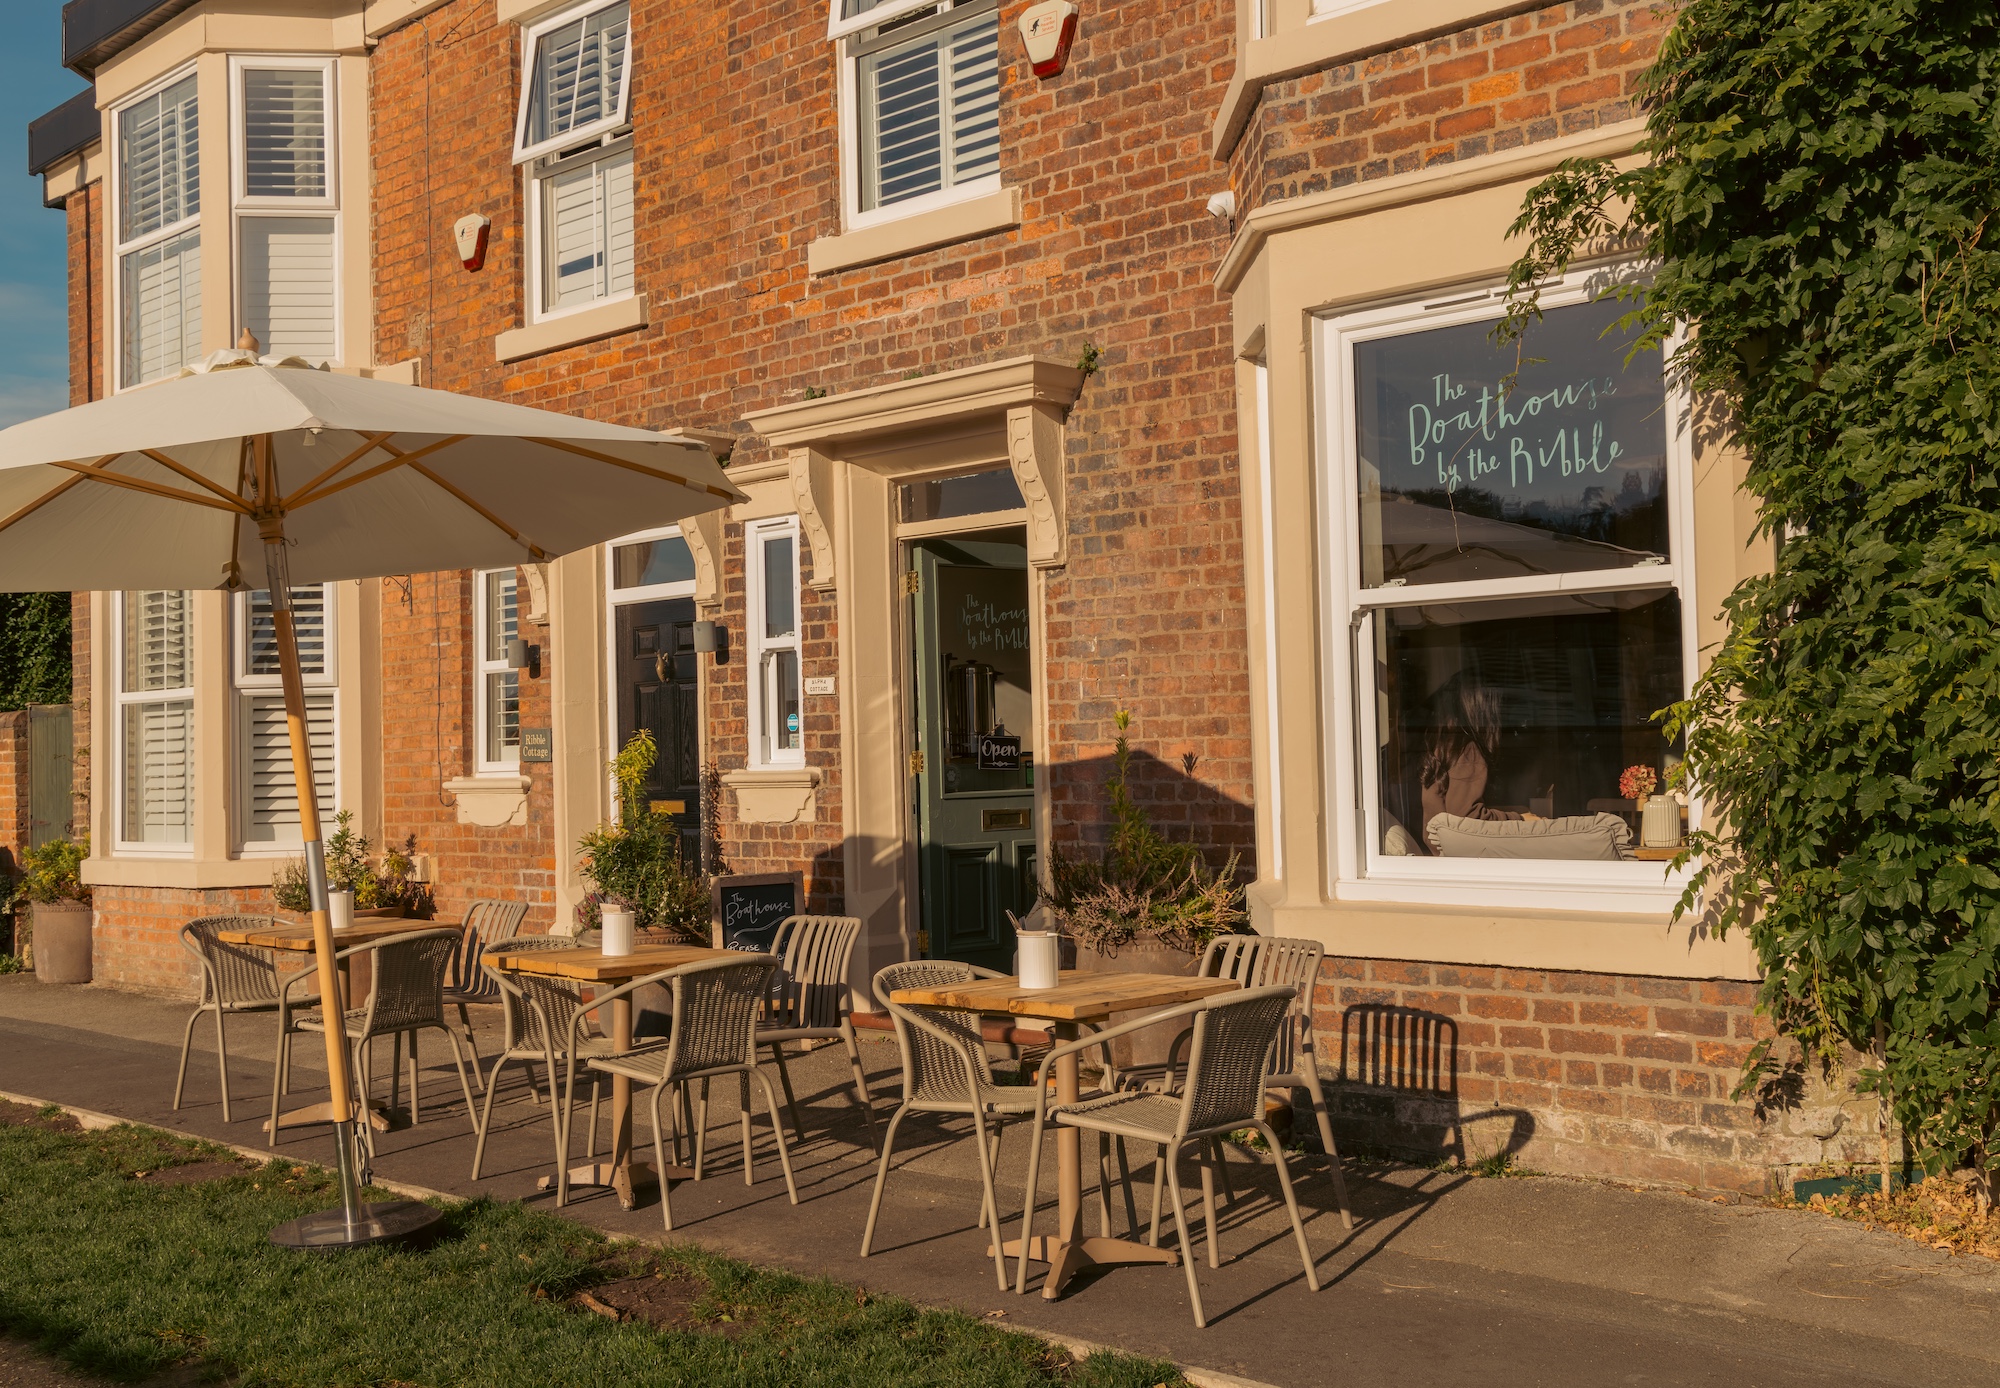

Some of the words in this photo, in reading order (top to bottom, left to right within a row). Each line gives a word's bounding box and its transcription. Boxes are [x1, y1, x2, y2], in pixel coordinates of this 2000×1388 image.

[1432, 373, 1467, 407] The
[1409, 376, 1618, 465] Boathouse
[1437, 451, 1462, 493] by
[1467, 448, 1500, 482] the
[1510, 420, 1623, 488] Ribble
[966, 593, 980, 609] The
[957, 603, 1029, 634] Boathous
[967, 629, 978, 650] by
[979, 630, 993, 646] the
[995, 626, 1030, 651] Ribbl
[525, 734, 546, 745] Ribble
[981, 739, 1019, 762] Open
[522, 746, 549, 759] Cottage
[731, 892, 745, 903] The
[726, 899, 791, 926] Boathouse
